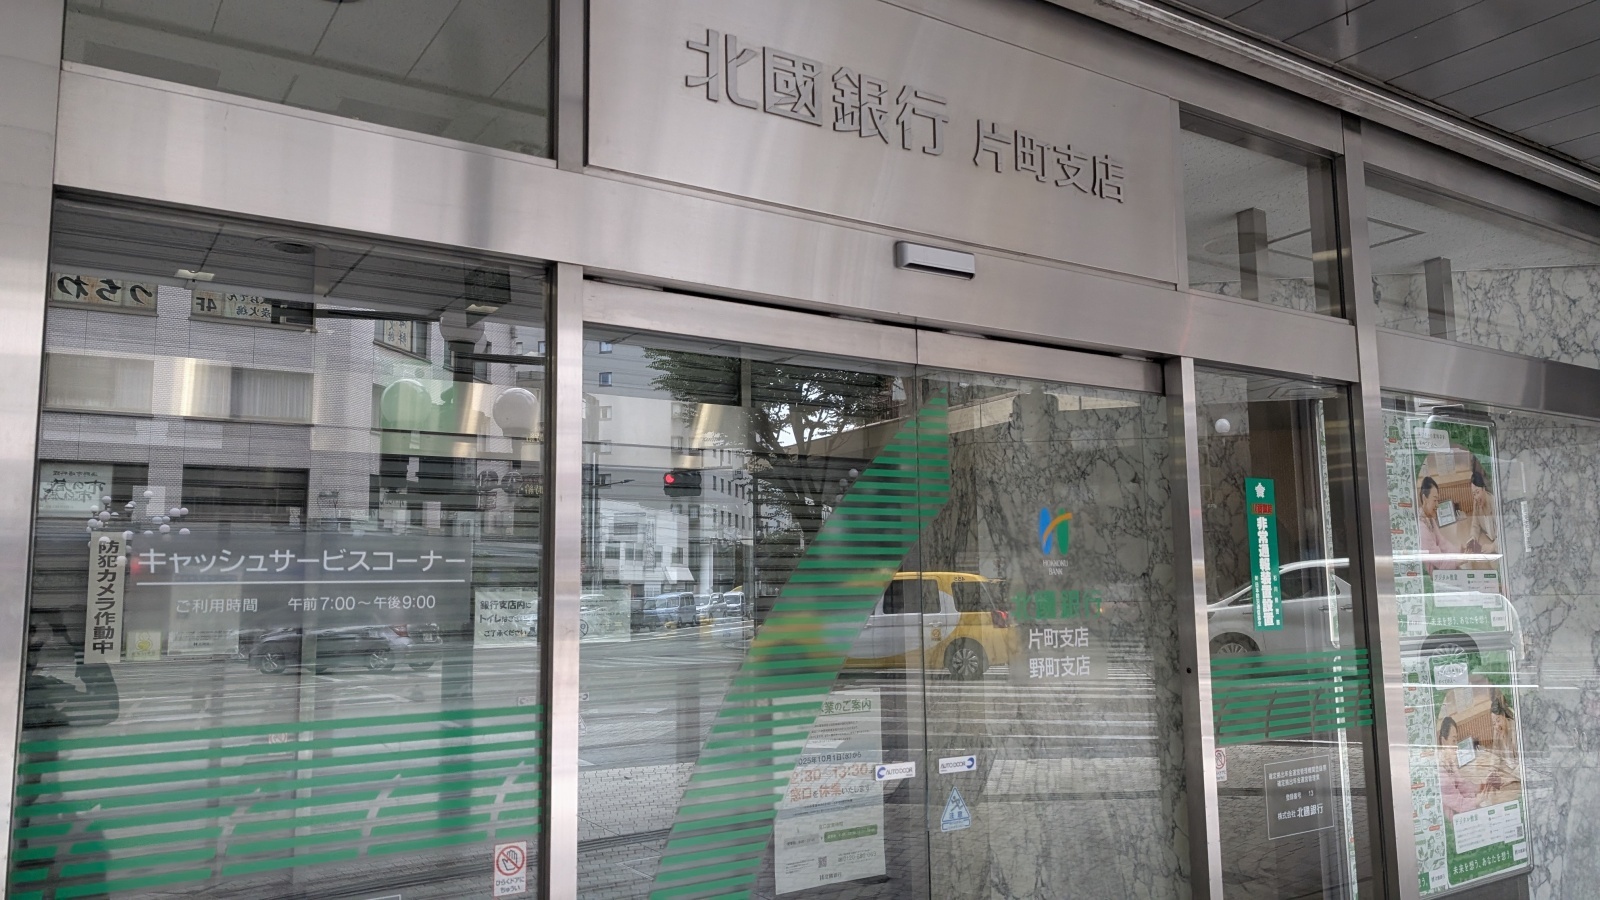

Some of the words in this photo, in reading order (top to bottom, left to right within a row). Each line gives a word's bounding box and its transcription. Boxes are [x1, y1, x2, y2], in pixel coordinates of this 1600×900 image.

[685, 28, 949, 156] 北國銀行
[973, 119, 1124, 204] 片町支店
[138, 548, 466, 574] キャッシュサービスコーナー
[1042, 559, 1069, 567] HOKKOKU
[93, 540, 119, 654] 防犯カメラ作動中
[176, 598, 258, 613] ご利用時間
[1011, 589, 1103, 621] 北國銀行
[1028, 626, 1089, 649] 片町支店
[1029, 655, 1090, 679] 野町支店
[821, 698, 872, 714] 業のご案内
